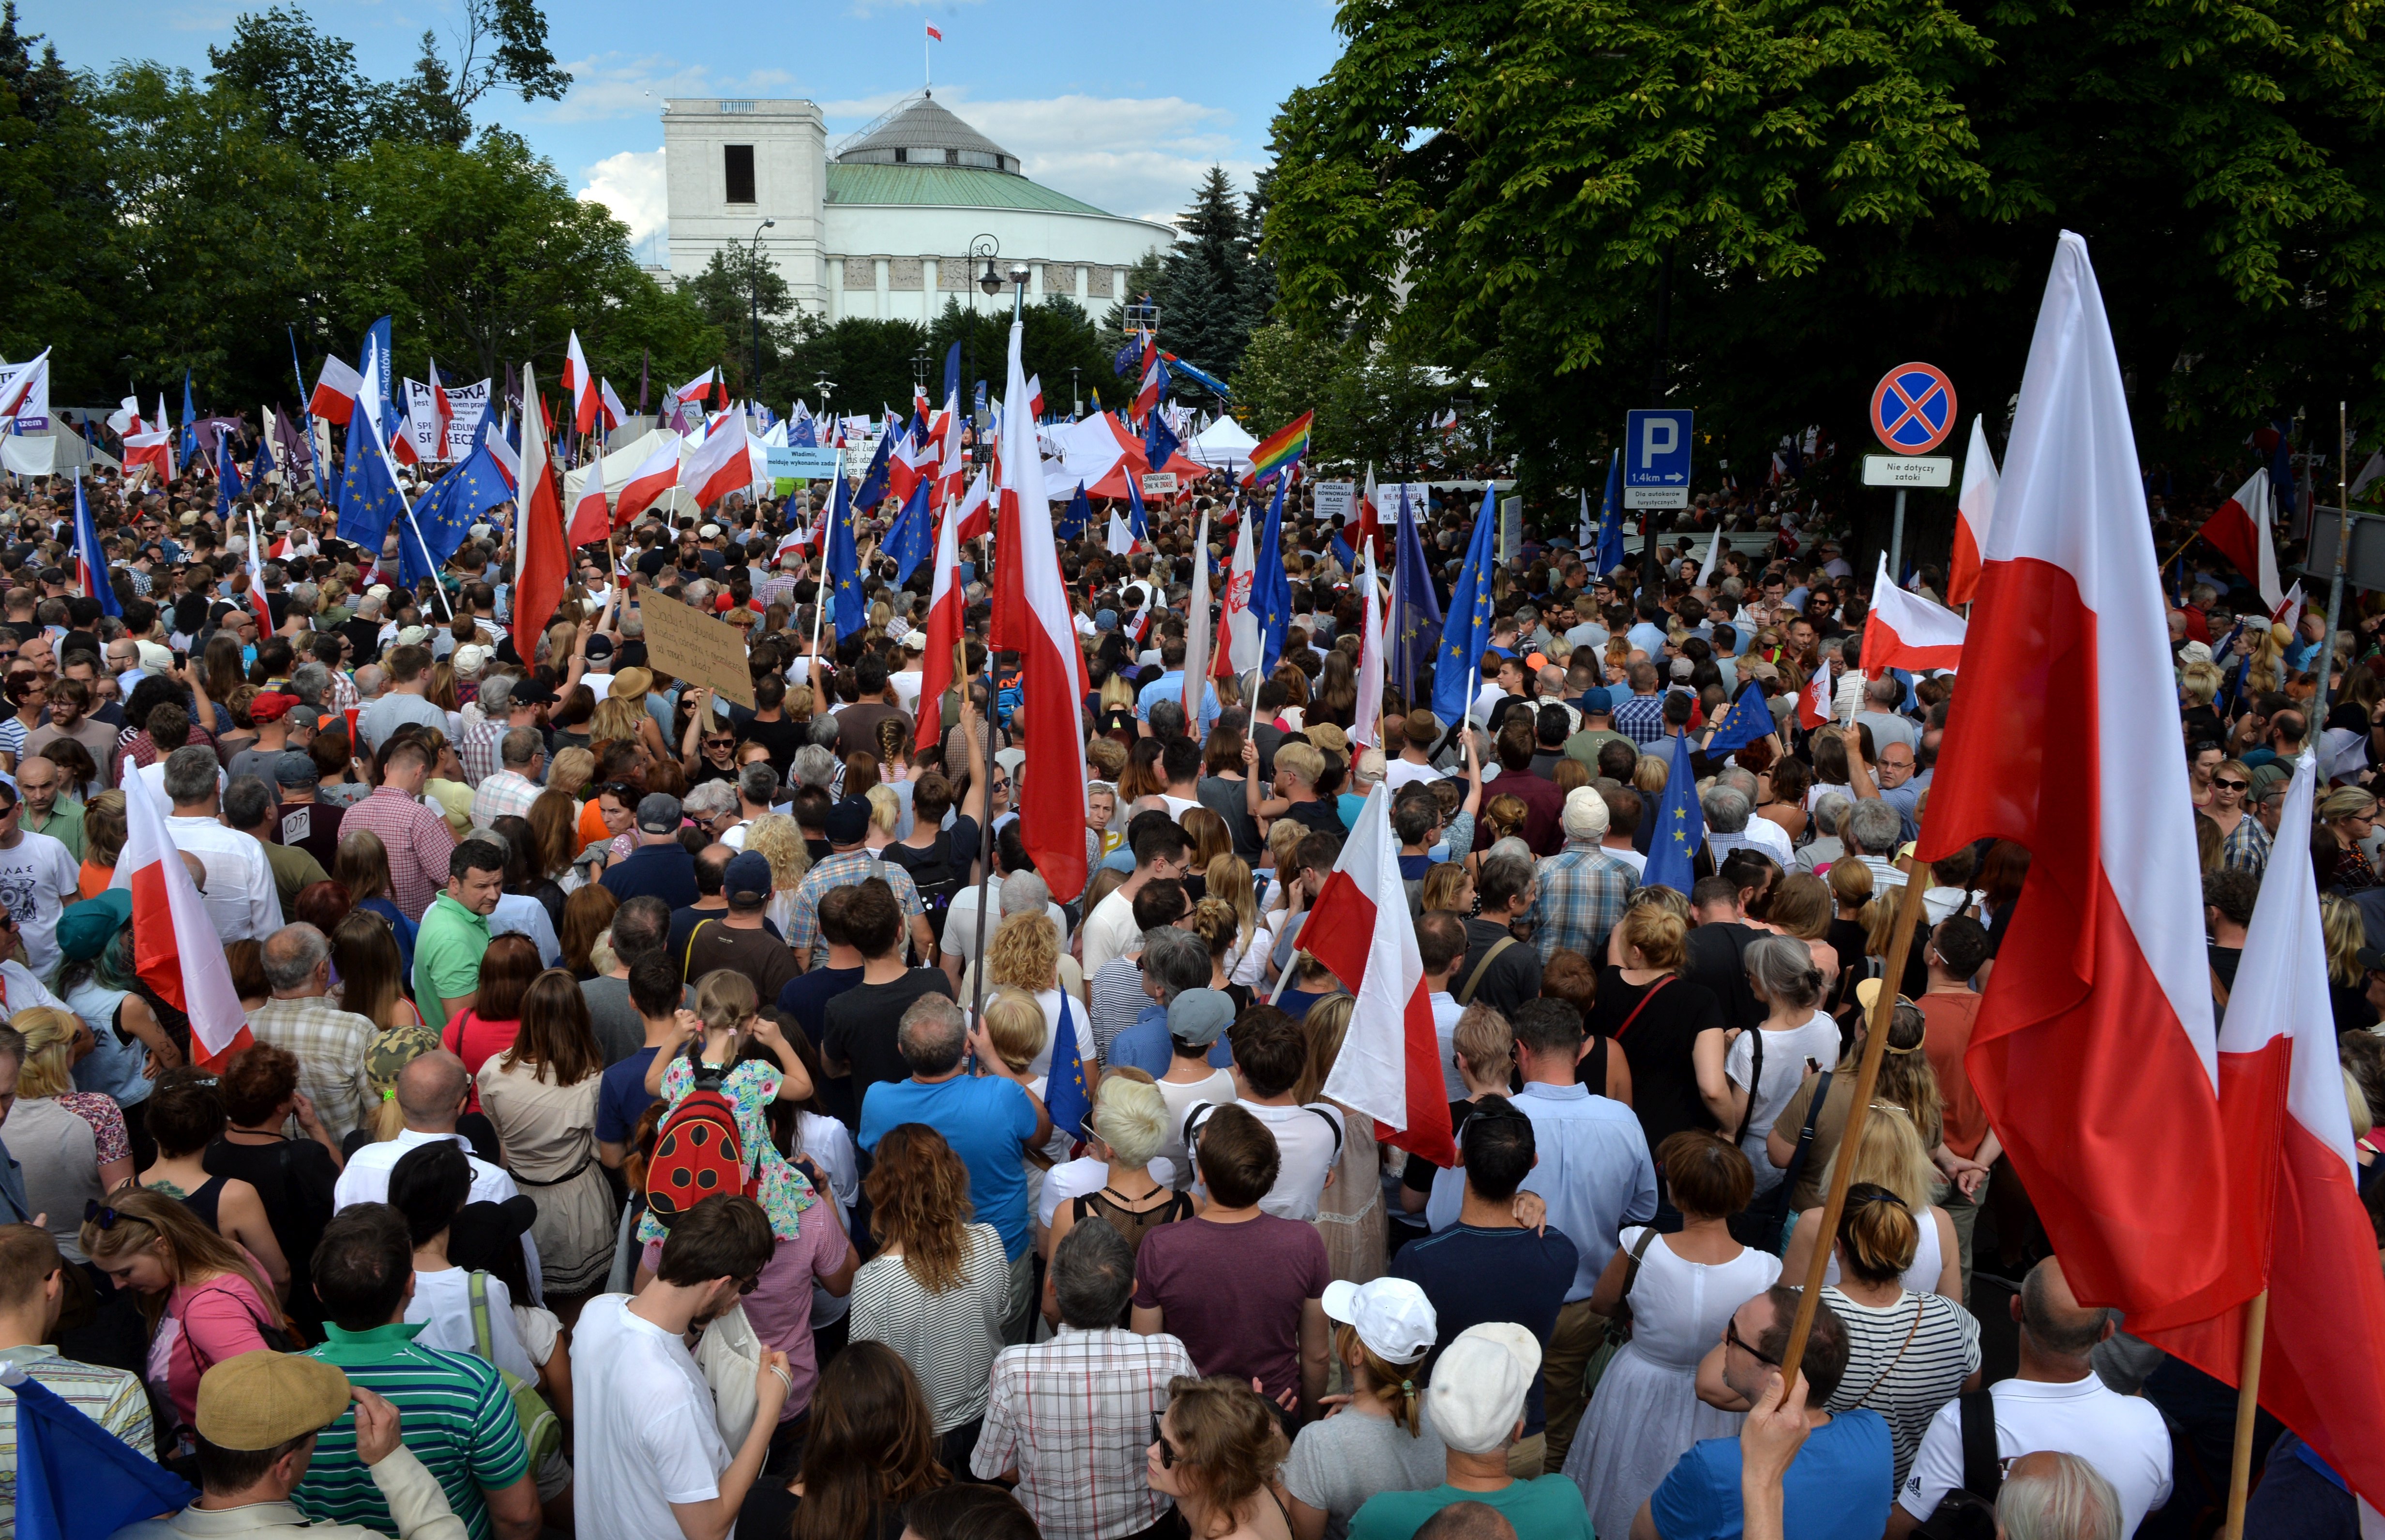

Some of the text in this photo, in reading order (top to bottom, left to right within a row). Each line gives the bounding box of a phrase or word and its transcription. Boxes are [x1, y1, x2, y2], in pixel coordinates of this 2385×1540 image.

[1642, 418, 1679, 468] P
[1904, 463, 1934, 473] dotyczy
[1632, 473, 1660, 483] 1,4km
